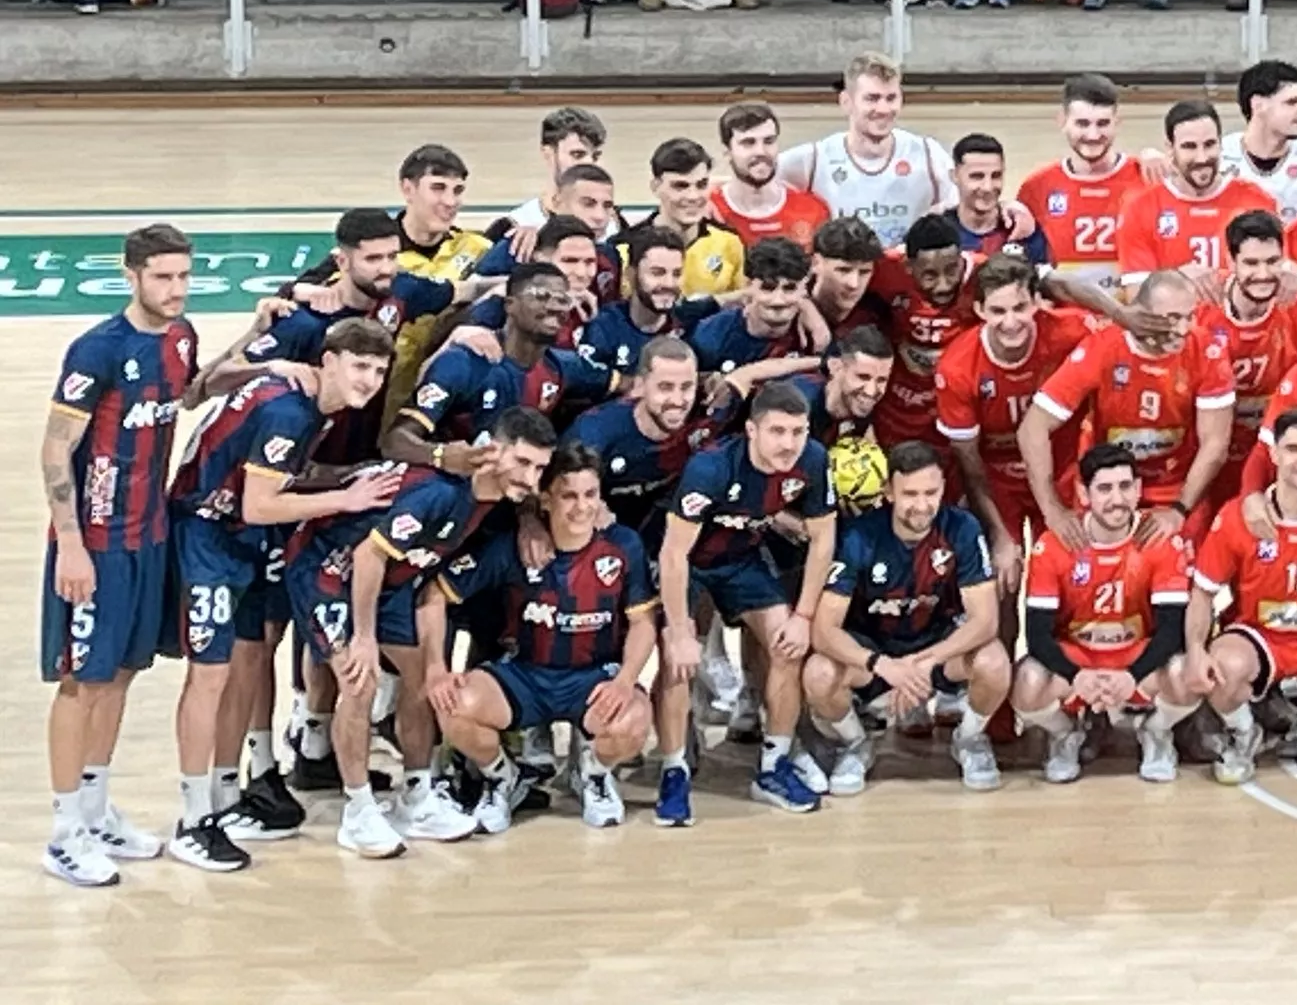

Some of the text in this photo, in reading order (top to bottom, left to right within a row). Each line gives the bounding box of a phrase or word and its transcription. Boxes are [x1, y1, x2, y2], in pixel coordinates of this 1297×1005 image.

[1074, 216, 1116, 252] 22
[1188, 236, 1220, 269] 31
[1233, 357, 1270, 391] 27
[1138, 390, 1161, 422] 9
[188, 585, 232, 624] 38
[1094, 581, 1124, 615] 21
[71, 601, 97, 639] 5
